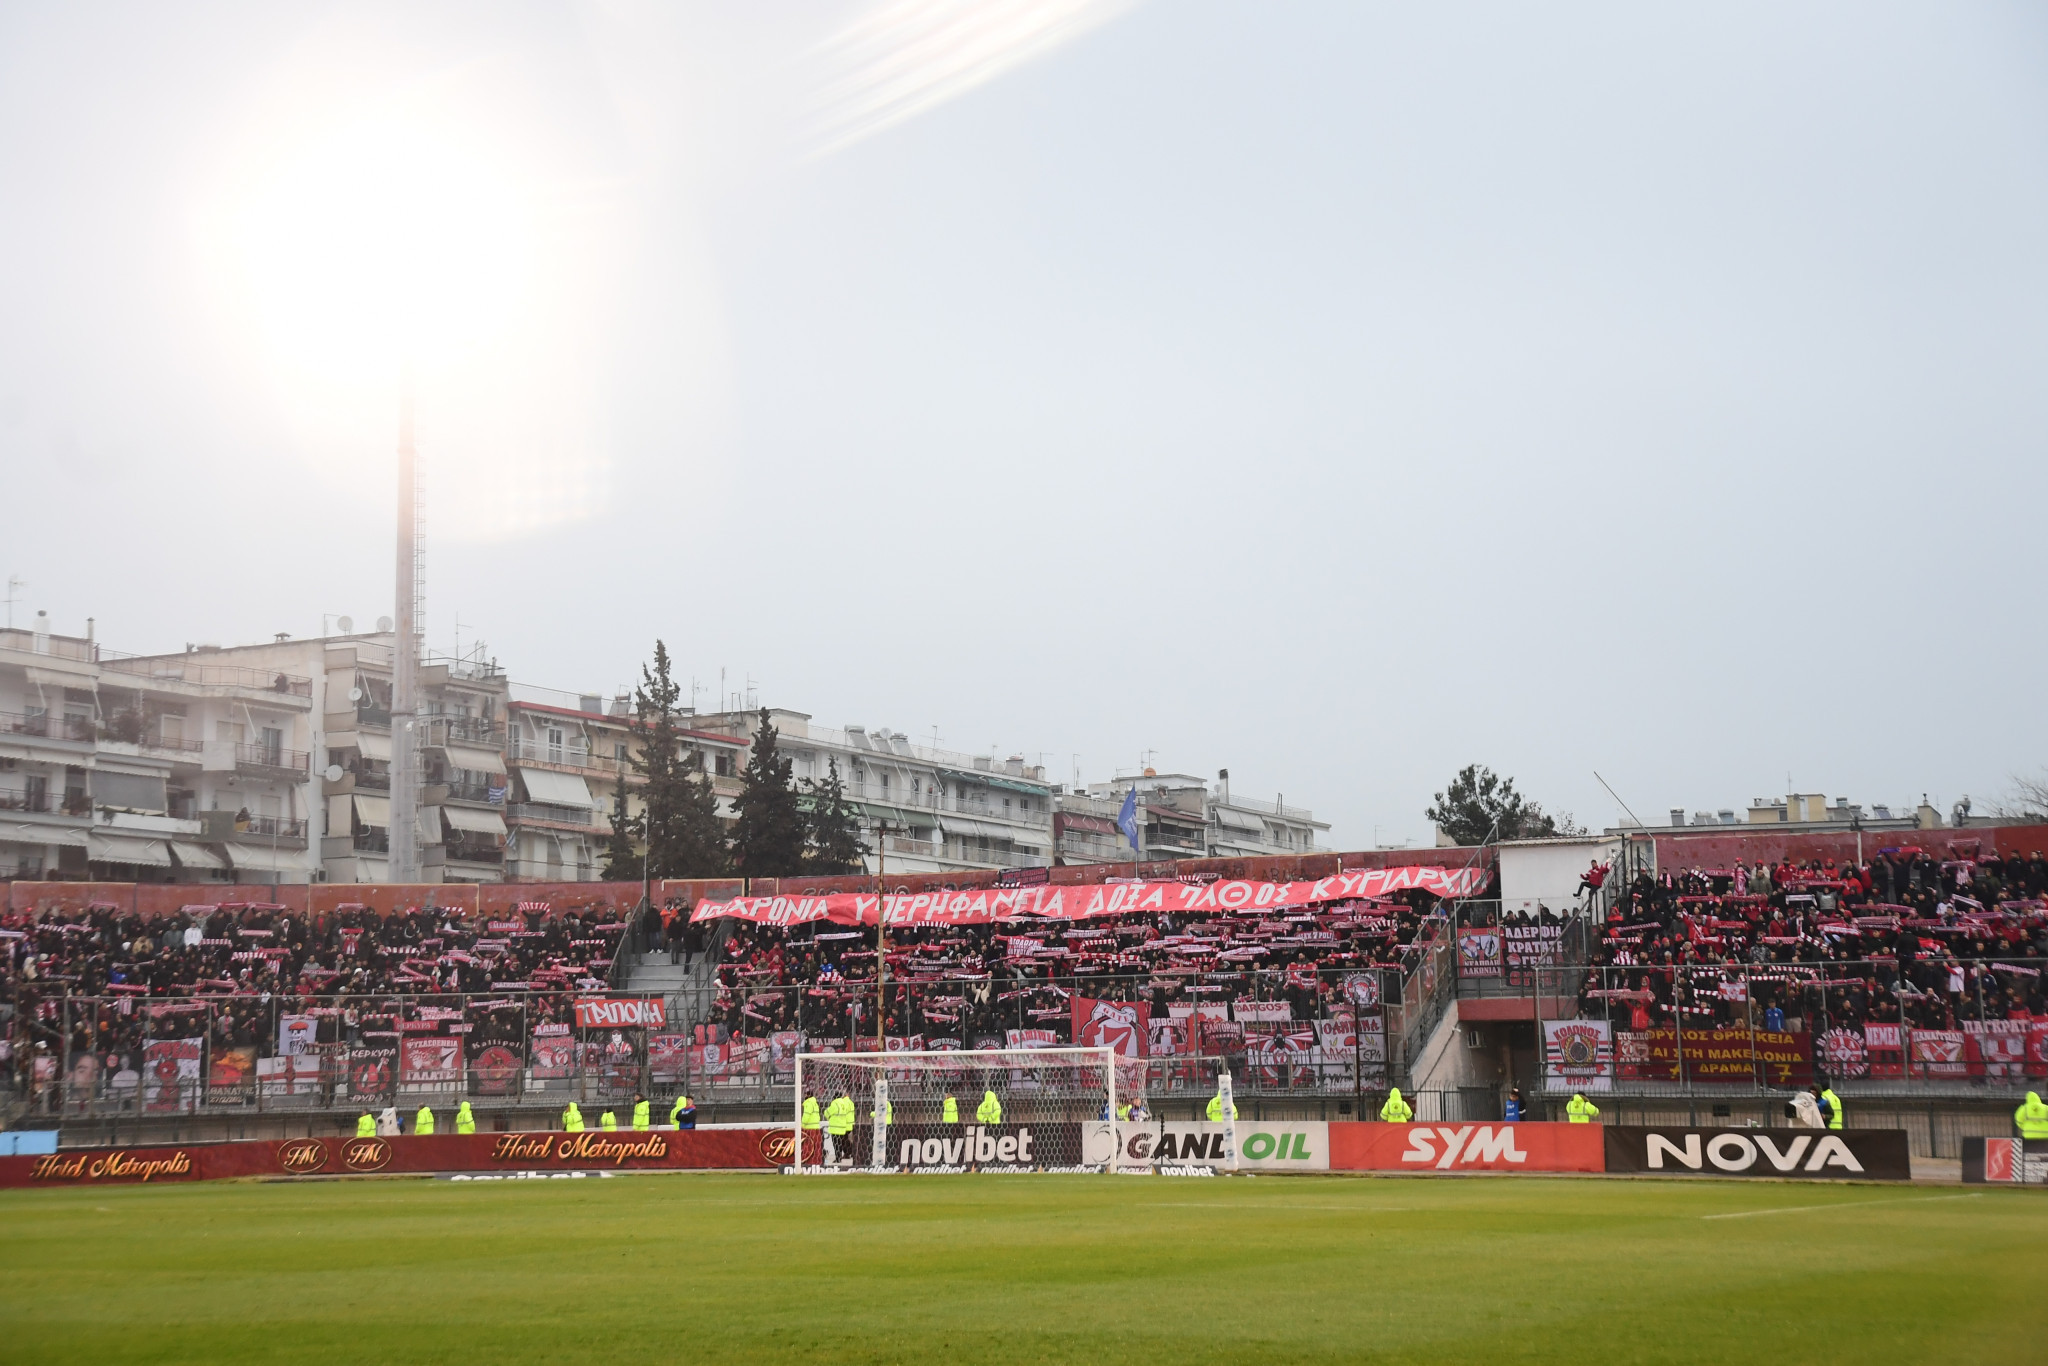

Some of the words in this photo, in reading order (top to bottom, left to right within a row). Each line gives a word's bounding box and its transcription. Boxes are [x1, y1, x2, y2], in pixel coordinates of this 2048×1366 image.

[1084, 884, 1163, 915] ΔΟΞΑ
[1505, 926, 1562, 939] ΑΔΕΡΦΙΑ
[1507, 940, 1563, 953] ΚΡΑΤΑΤΕ
[1242, 1003, 1282, 1012] ARGOS
[534, 1023, 570, 1035] ΛΑΜΙΑ
[1713, 1030, 1794, 1044] ΘΡΗΣΚΕΙΑ
[351, 1048, 397, 1058] ΚΕΡΚΥΡΑ
[1708, 1047, 1804, 1062] ΜΑΚΕΔΟΝΙΑ
[1700, 1063, 1753, 1073] ΔΡΑΜΑ
[492, 1134, 555, 1160] Hotel
[558, 1132, 667, 1165] Metropolis
[901, 1126, 1033, 1165] novibet
[1401, 1126, 1527, 1169] SYM
[1646, 1133, 1865, 1172] NOVA
[89, 1151, 191, 1182] Metropolis
[1161, 1165, 1215, 1177] novibet
